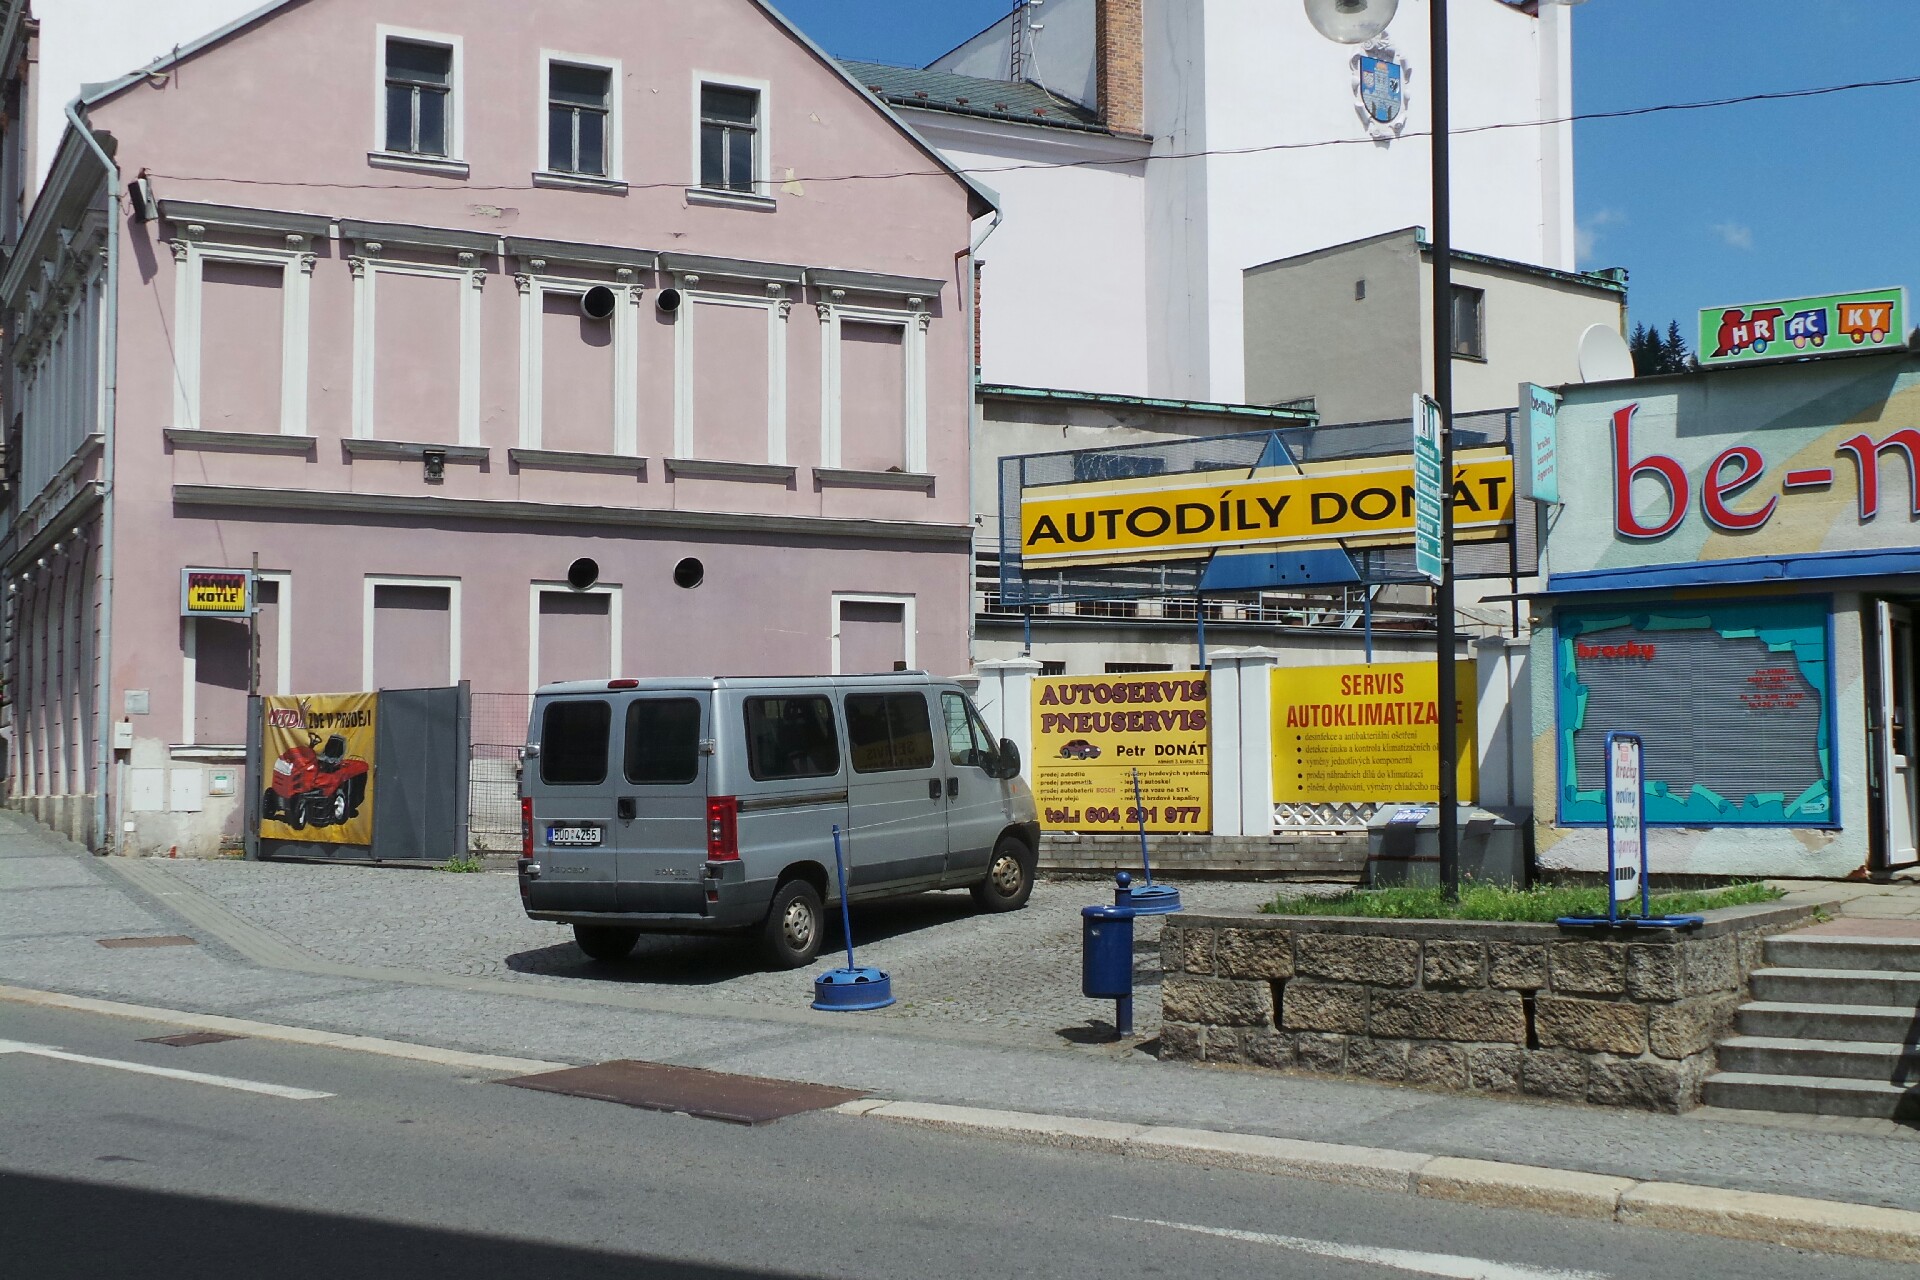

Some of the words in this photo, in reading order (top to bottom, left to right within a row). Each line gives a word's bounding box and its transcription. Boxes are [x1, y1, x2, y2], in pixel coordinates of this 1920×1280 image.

[1530, 389, 1555, 418] be-max
[1026, 490, 1292, 547] AUTODÍLY
[196, 592, 237, 602] KOTLE
[1340, 672, 1405, 696] SERVIS
[1039, 679, 1208, 706] AUTOSERVIS
[1041, 709, 1207, 733] PNEUSERVIS
[1286, 700, 1464, 728] AUTOKLIMATIZAE
[1304, 733, 1338, 741] desinfekce
[1345, 731, 1390, 740] antibakteriální
[1391, 730, 1418, 739] ošetření
[1116, 744, 1146, 757] Petr
[1154, 741, 1207, 756] DONÁT
[1305, 745, 1329, 753] detekce
[1354, 743, 1381, 752] kontrola
[1382, 742, 1431, 751] klimatizačních
[1330, 756, 1371, 767] jednotlivých
[1040, 771, 1060, 779] prodej
[1306, 770, 1326, 781] prodej
[1326, 769, 1361, 779] náhradních
[1376, 769, 1386, 778] do
[1366, 782, 1393, 793] výměny
[1615, 787, 1636, 809] noviny
[1044, 806, 1081, 824] tel.:
[1085, 806, 1121, 824] 604
[1164, 806, 1202, 824] 977
[575, 828, 597, 841] 4255
